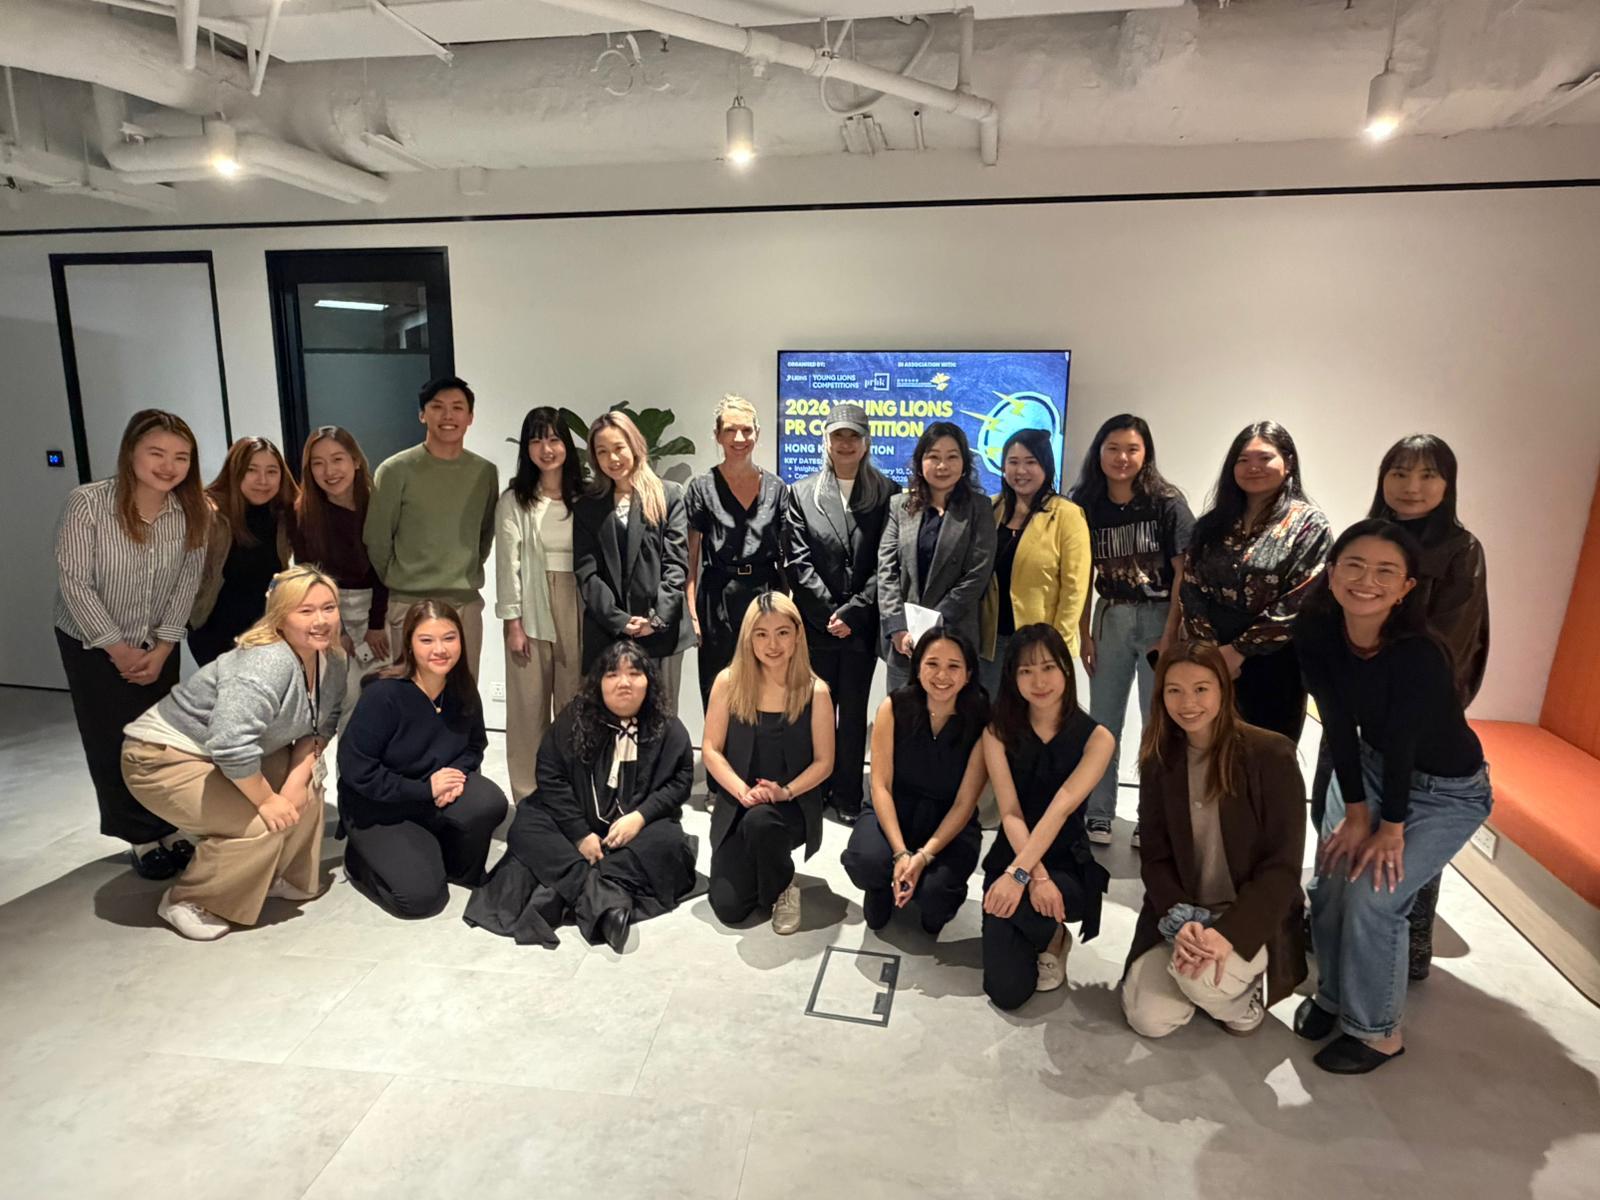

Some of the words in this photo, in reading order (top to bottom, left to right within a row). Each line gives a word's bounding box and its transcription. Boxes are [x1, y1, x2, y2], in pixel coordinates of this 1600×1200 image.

[785, 399, 830, 416] 2026
[900, 400, 953, 417] LIONS
[785, 419, 807, 435] PR
[784, 444, 815, 453] HONG
[1136, 519, 1160, 553] MAC
